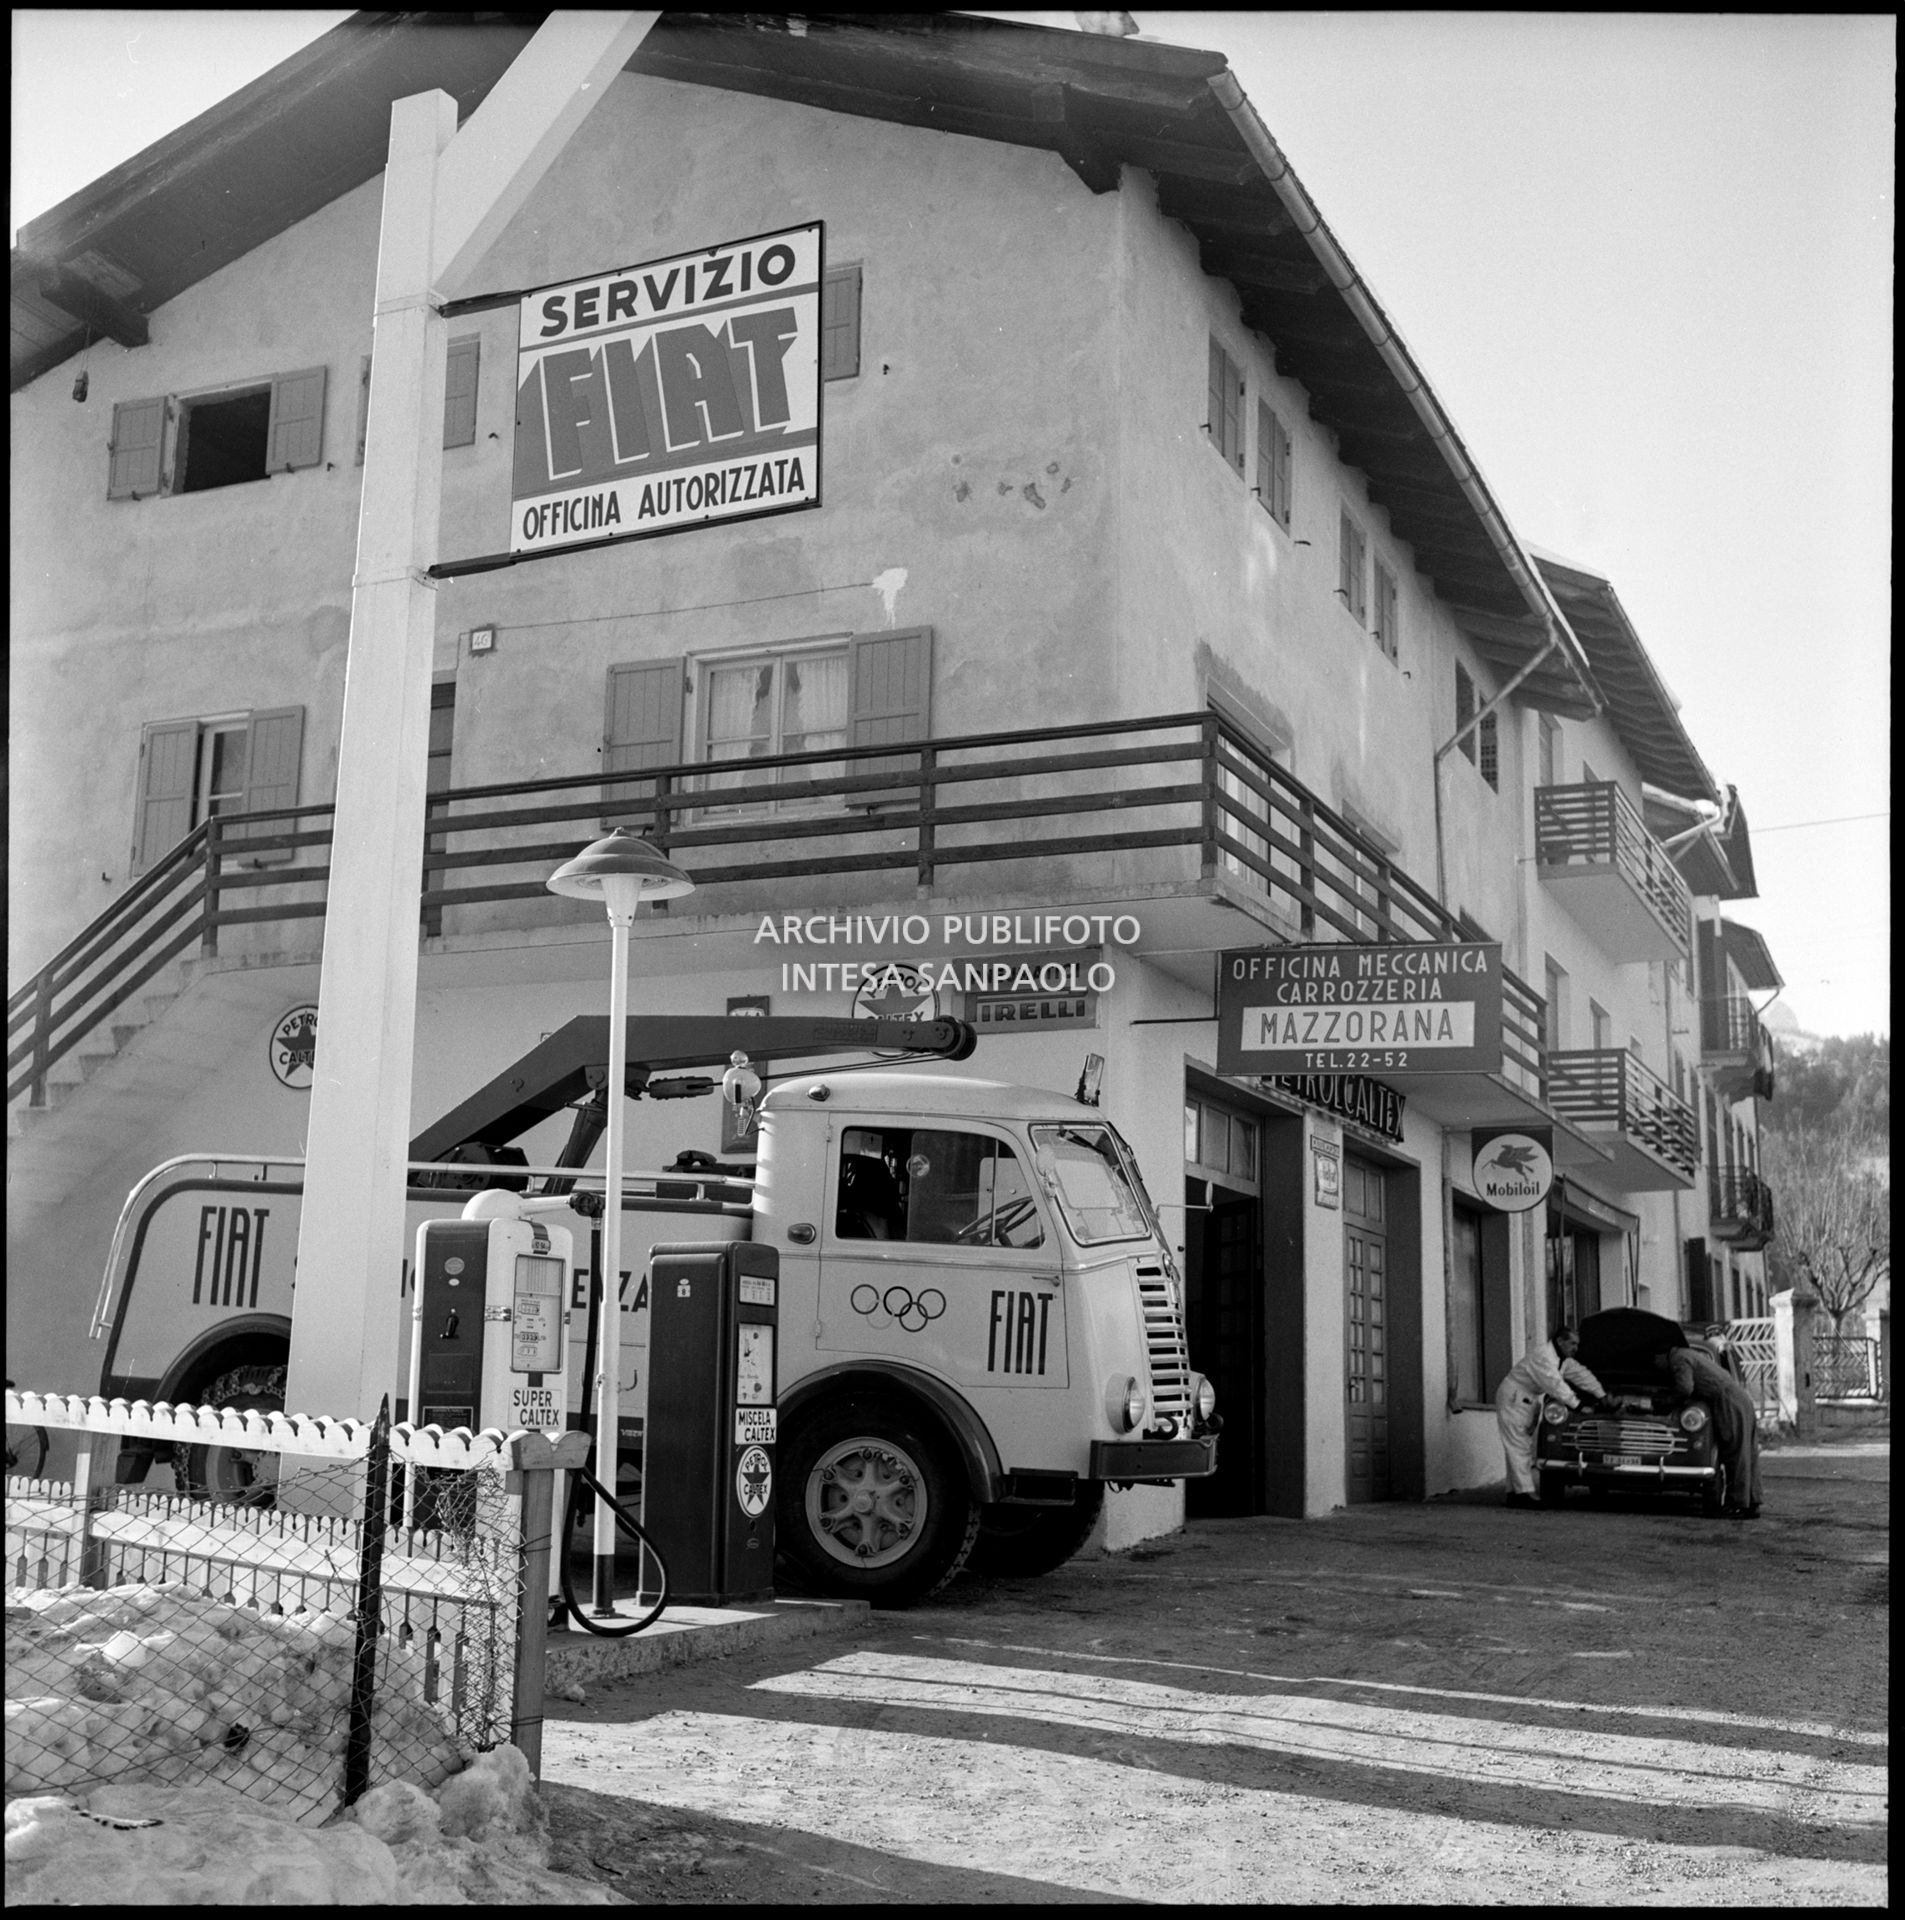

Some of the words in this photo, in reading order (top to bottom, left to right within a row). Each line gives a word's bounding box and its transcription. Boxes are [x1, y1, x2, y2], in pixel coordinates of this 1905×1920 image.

[539, 243, 796, 338] SERVIZIO
[540, 306, 799, 481] FIAT
[523, 490, 621, 541] OFFICINA
[637, 456, 806, 520] AUTORIZZATA
[1233, 955, 1341, 981] OFFICINA
[1358, 950, 1488, 978] MECCANICA
[1277, 977, 1442, 1004] CARROZZERIA
[1260, 1008, 1454, 1045] MAZZORANA
[1486, 1181, 1540, 1197] Mobiloil
[192, 1205, 270, 1308] FIAT
[987, 1290, 1054, 1376] FIAT
[513, 1389, 552, 1407] SUPER
[520, 1408, 559, 1426] CALTEX
[738, 1410, 771, 1426] MISCELA
[744, 1427, 775, 1442] CALTEX
[743, 1483, 768, 1496] CALTEX
